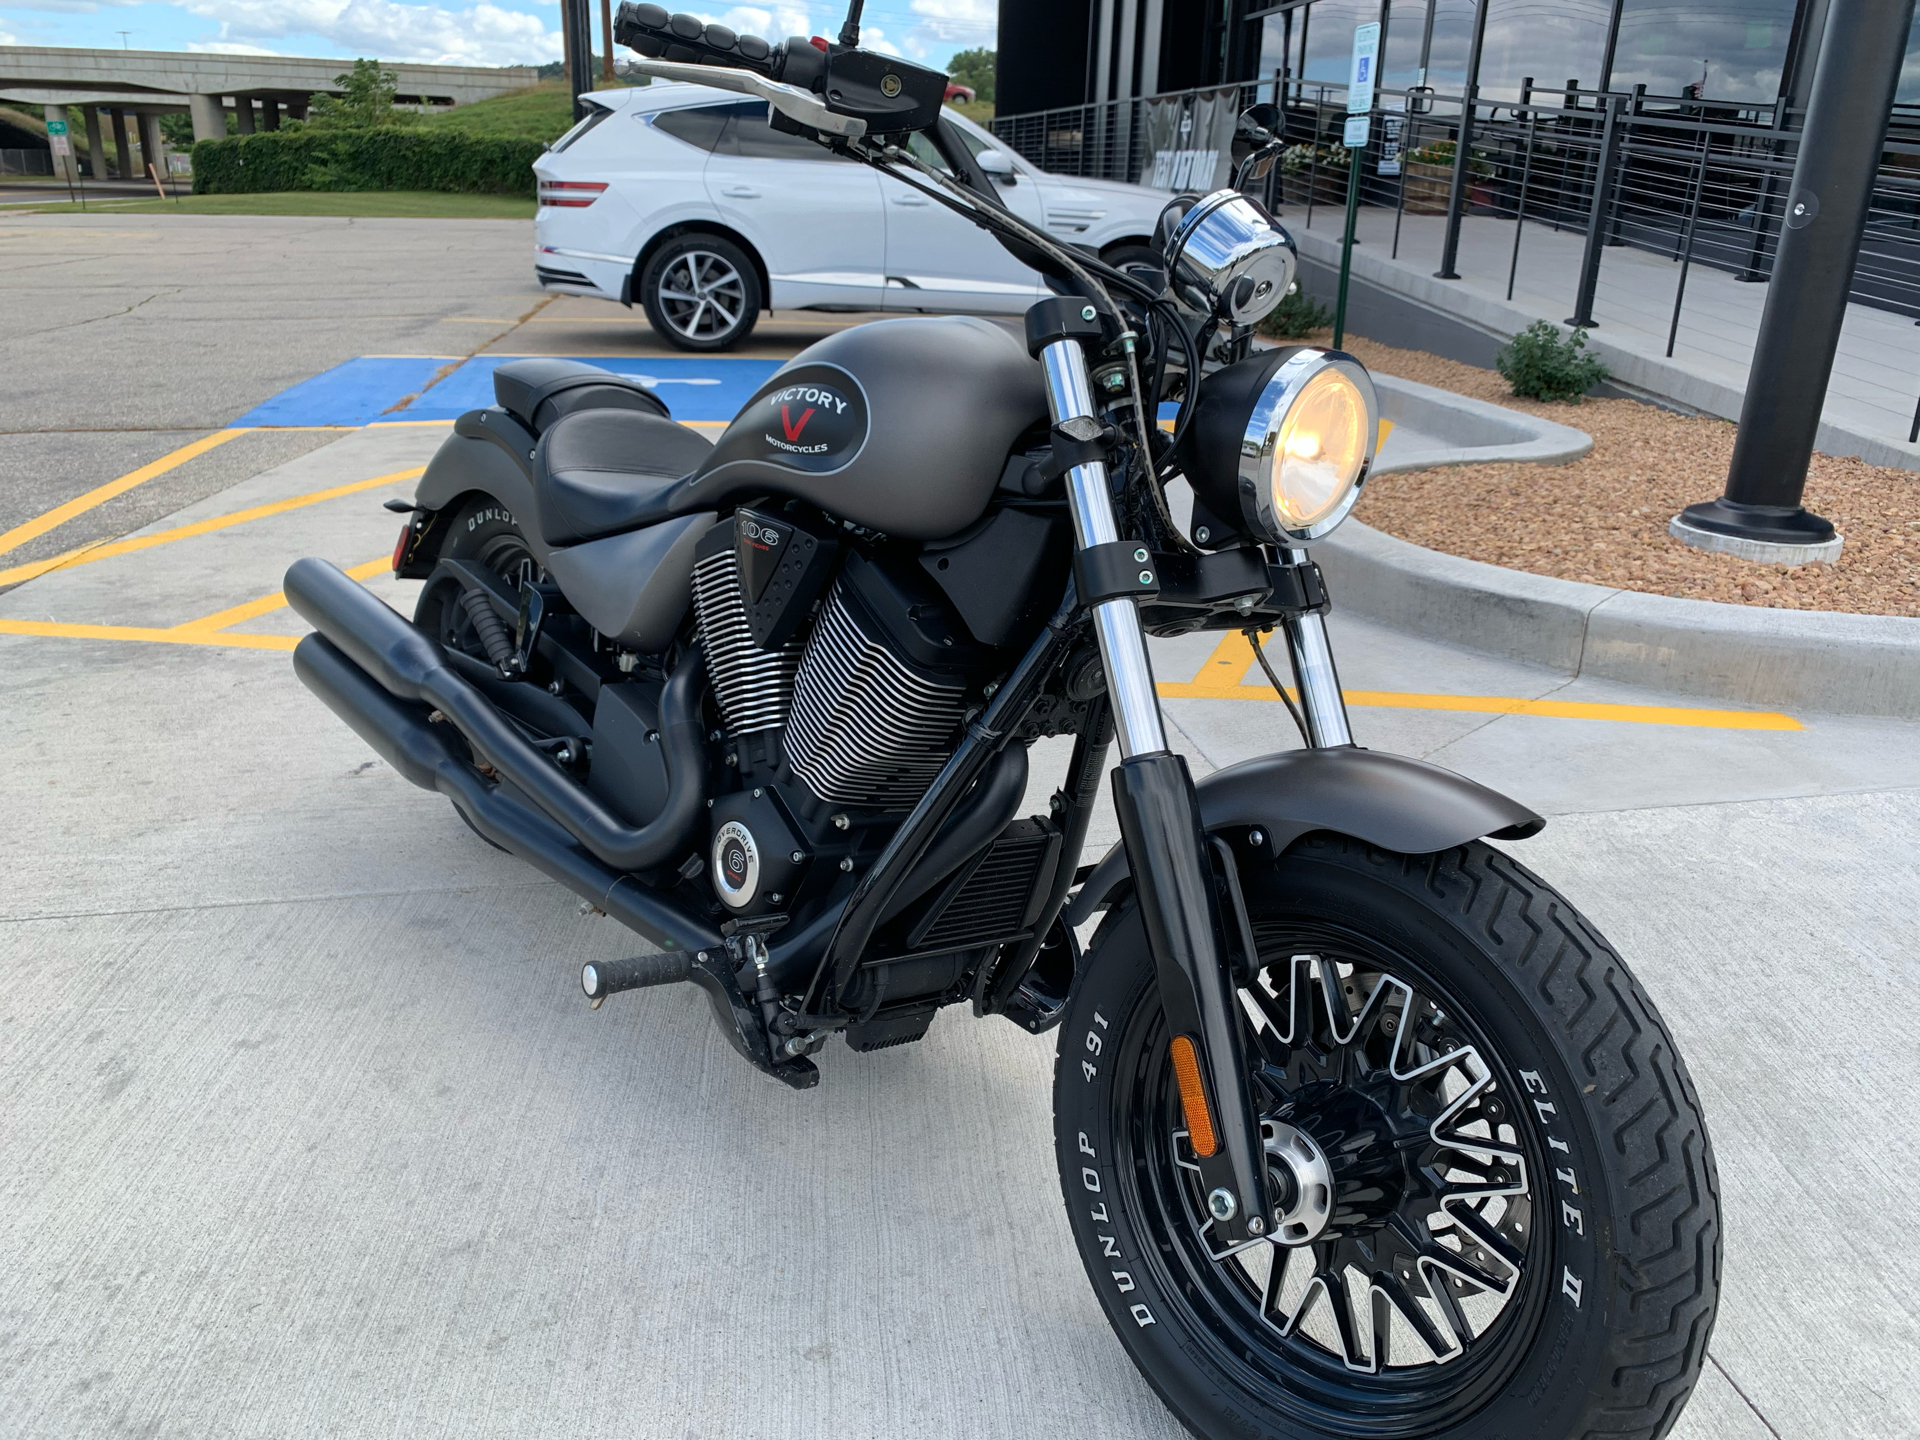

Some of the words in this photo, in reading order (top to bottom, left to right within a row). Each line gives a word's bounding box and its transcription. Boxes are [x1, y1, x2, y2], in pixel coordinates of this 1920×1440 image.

[770, 387, 847, 415] VICTORY
[781, 404, 817, 442] V
[765, 433, 828, 454] MOTORCYCLES
[741, 520, 780, 546] 106
[716, 827, 754, 864] OVERDRIVE
[728, 849, 745, 874] 6
[1081, 1010, 1109, 1083] 491
[1518, 1068, 1585, 1236] ELITE
[1561, 1265, 1584, 1309] II
[1078, 1130, 1158, 1328] DUNLOP
